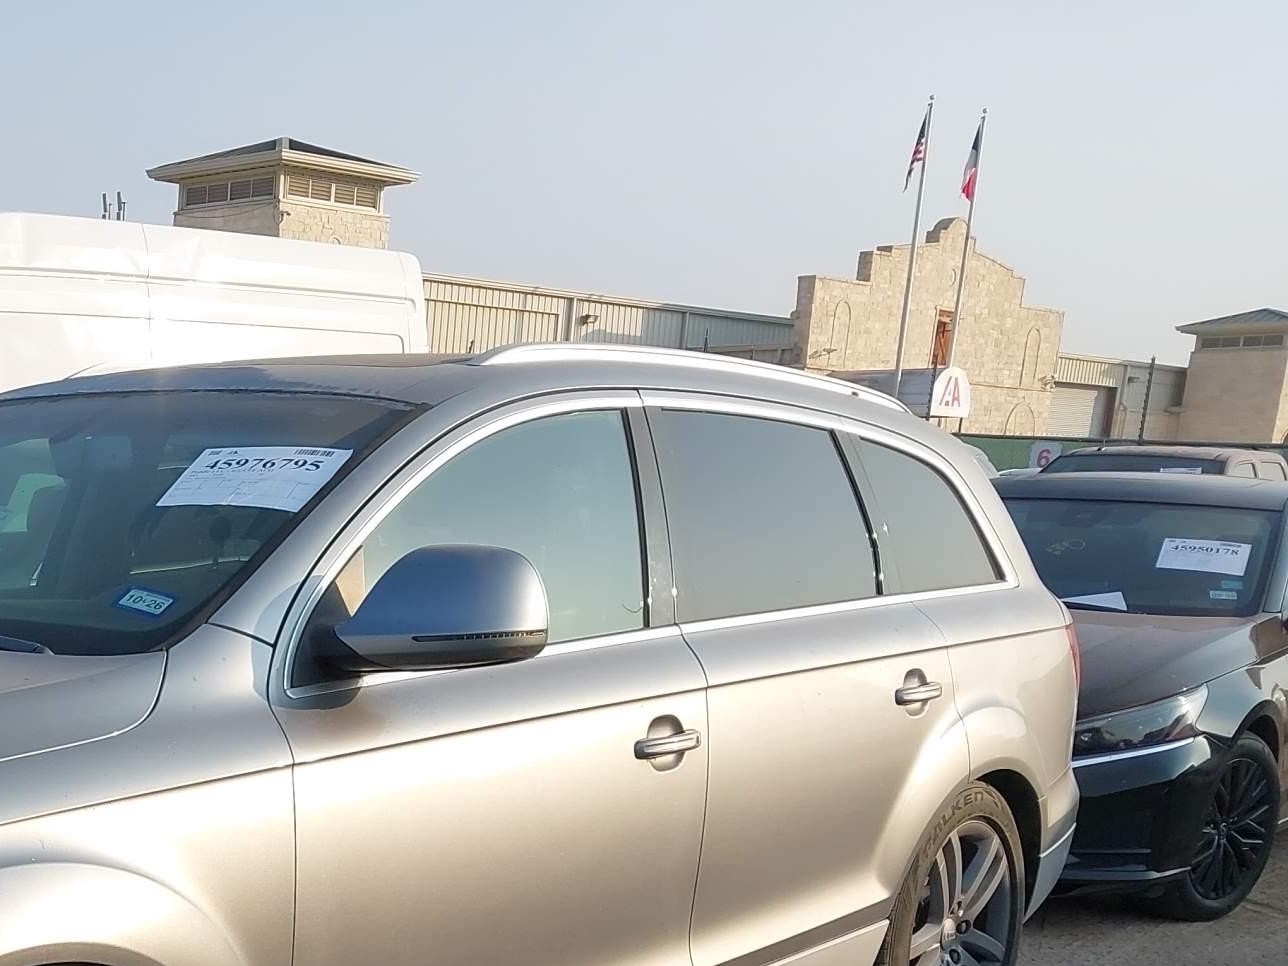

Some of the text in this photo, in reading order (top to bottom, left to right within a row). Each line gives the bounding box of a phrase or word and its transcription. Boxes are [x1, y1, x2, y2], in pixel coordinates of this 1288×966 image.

[204, 457, 326, 472] 45976795
[1036, 448, 1052, 468] 6
[1170, 544, 1240, 556] 45950178
